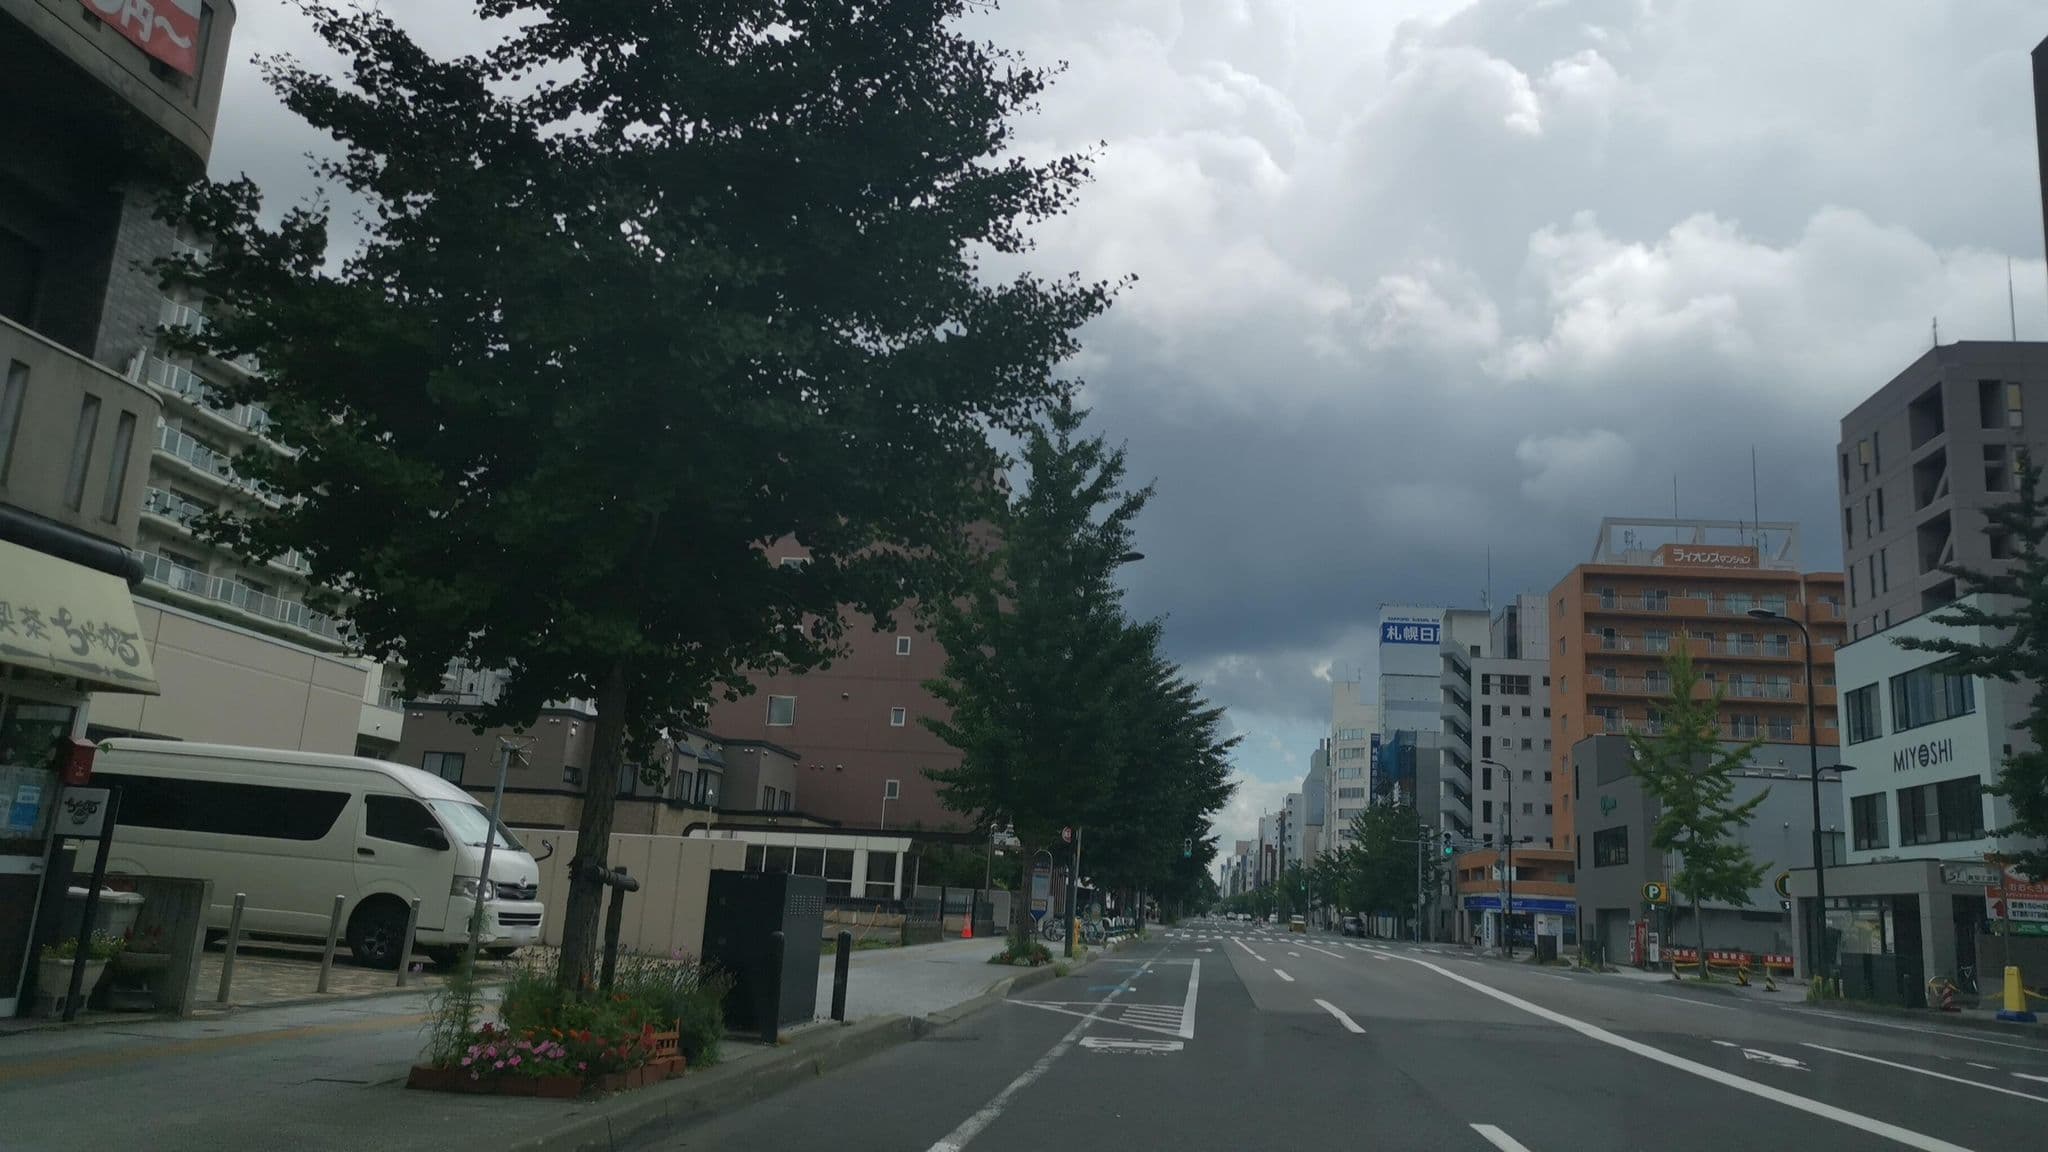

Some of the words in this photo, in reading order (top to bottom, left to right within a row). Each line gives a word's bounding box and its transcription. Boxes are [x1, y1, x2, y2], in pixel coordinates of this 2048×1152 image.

[1386, 624, 1440, 642] 札幌日
[1893, 738, 1953, 773] MIYOSHI
[1648, 885, 1660, 899] P
